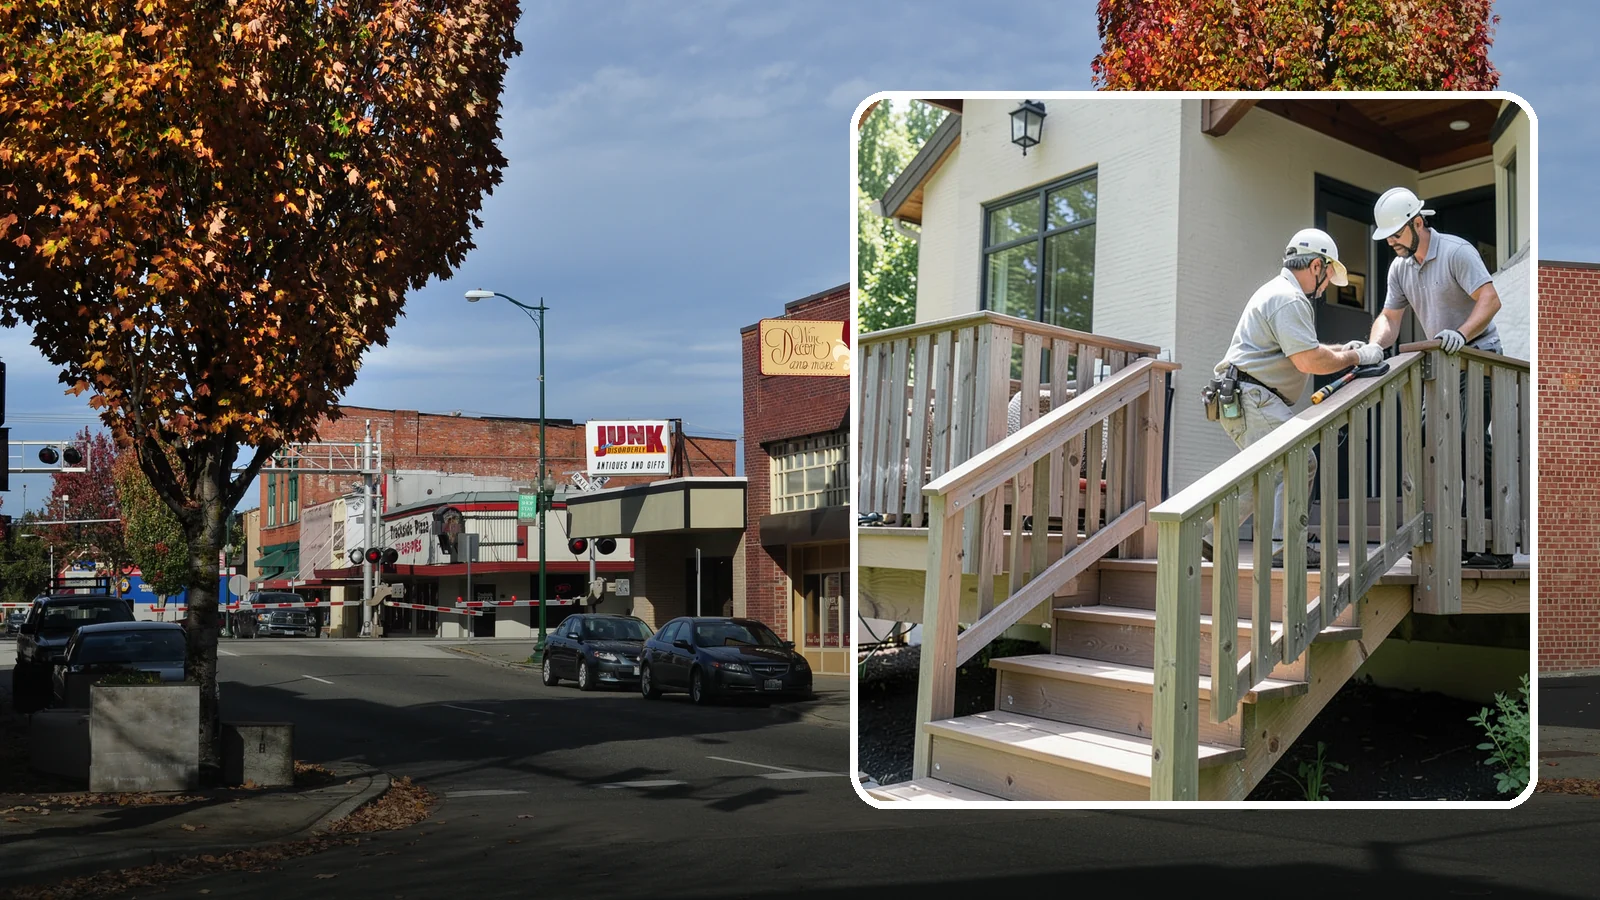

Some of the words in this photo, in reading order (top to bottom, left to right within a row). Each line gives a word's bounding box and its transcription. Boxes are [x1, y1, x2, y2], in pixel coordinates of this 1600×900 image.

[596, 425, 665, 457] JUNK
[607, 446, 645, 454] DISORDERLY
[597, 461, 628, 470] ANTIQUES
[631, 461, 644, 470] AND
[647, 460, 665, 470] GIFTS
[414, 519, 429, 535] Pizza
